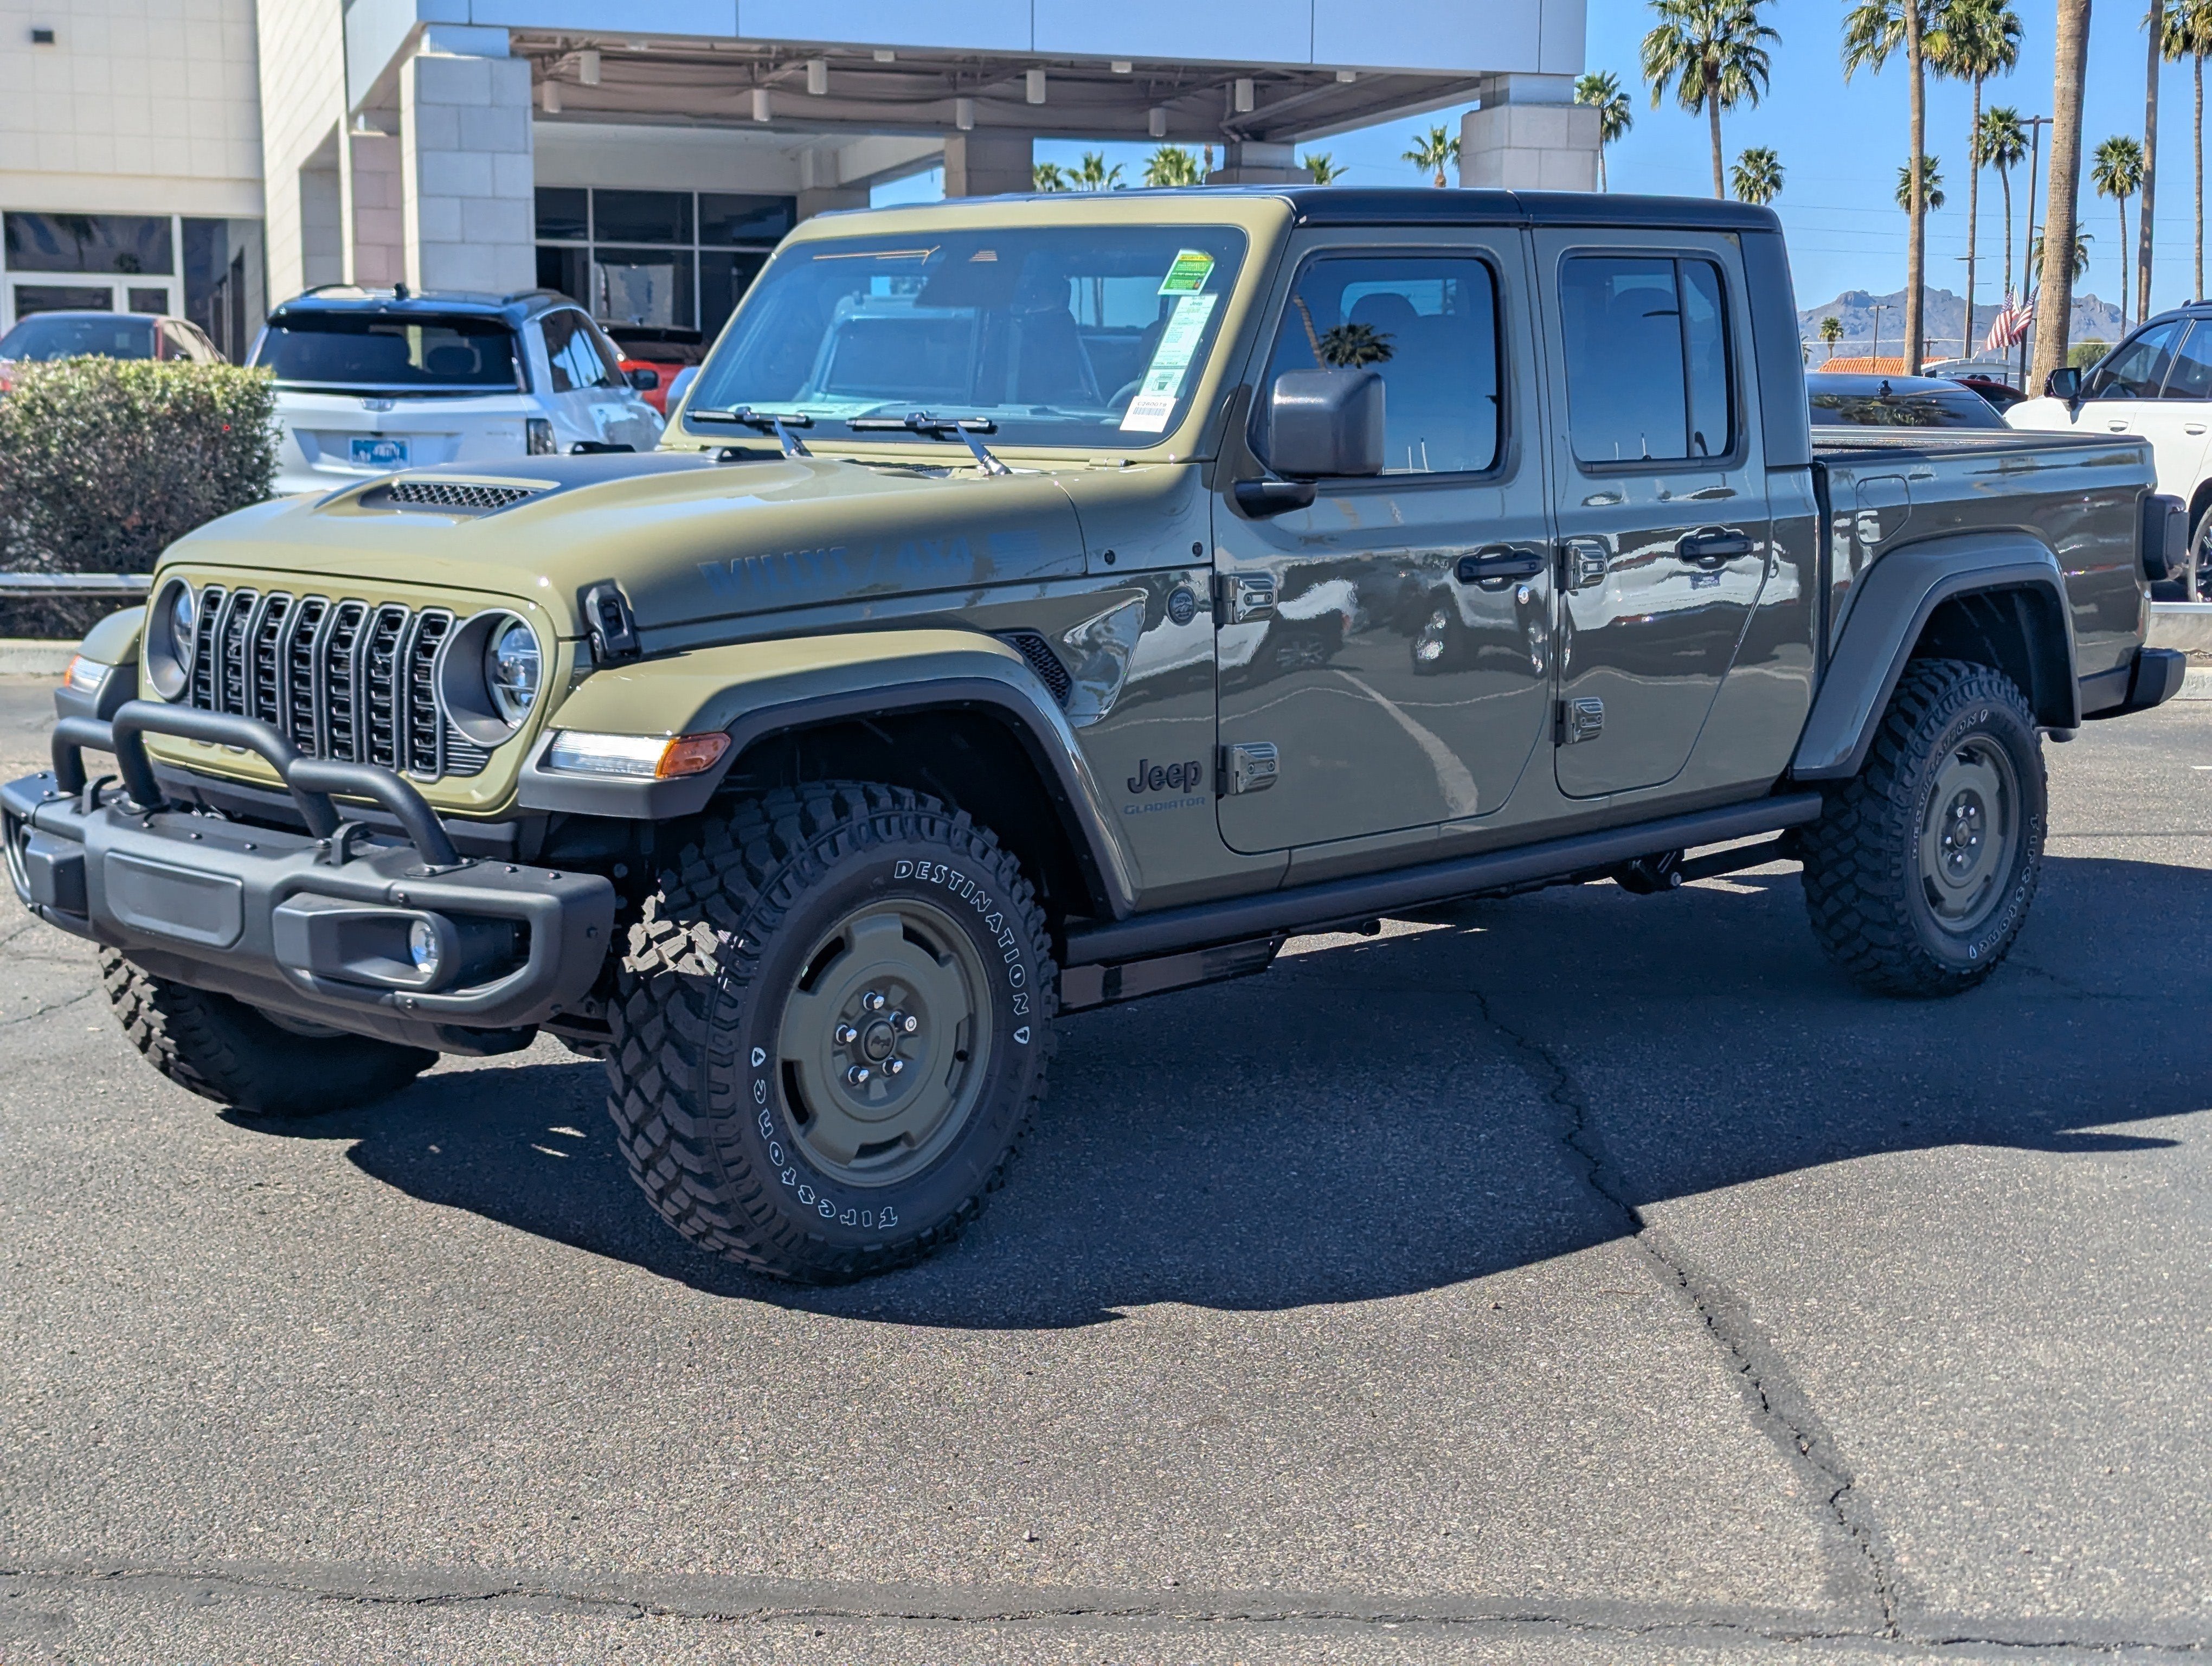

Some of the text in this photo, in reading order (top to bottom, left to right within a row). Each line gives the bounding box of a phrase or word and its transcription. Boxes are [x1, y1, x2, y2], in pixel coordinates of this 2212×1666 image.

[1127, 759, 1203, 794] Jeep
[1124, 797, 1206, 815] GLADIATOR
[893, 860, 1030, 1015] DESTINATION
